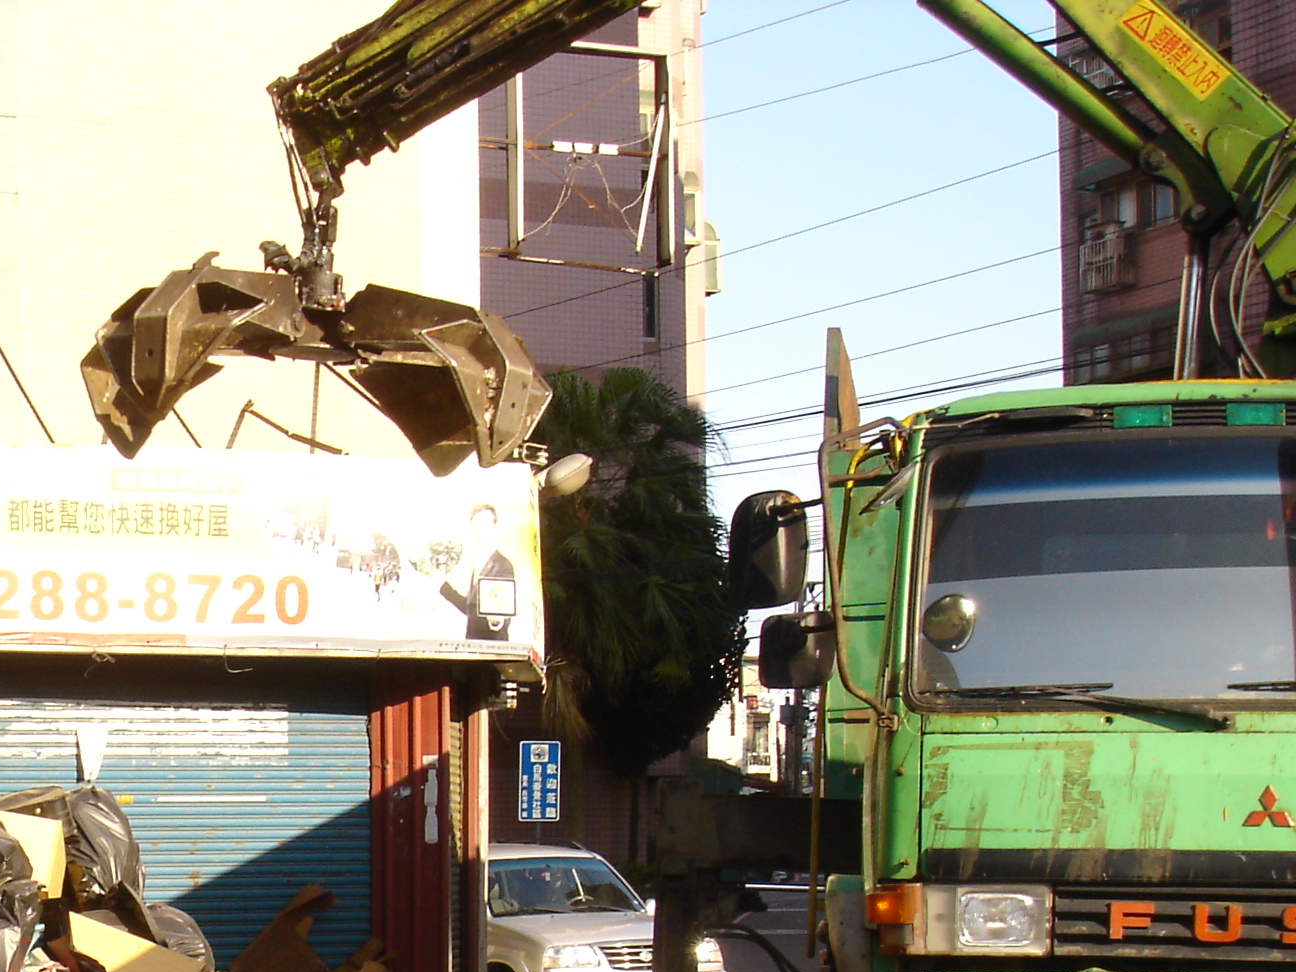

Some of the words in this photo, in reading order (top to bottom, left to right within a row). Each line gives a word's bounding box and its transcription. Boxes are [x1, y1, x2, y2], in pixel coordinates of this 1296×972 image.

[8, 499, 229, 536] 都能幫您快速換好屋
